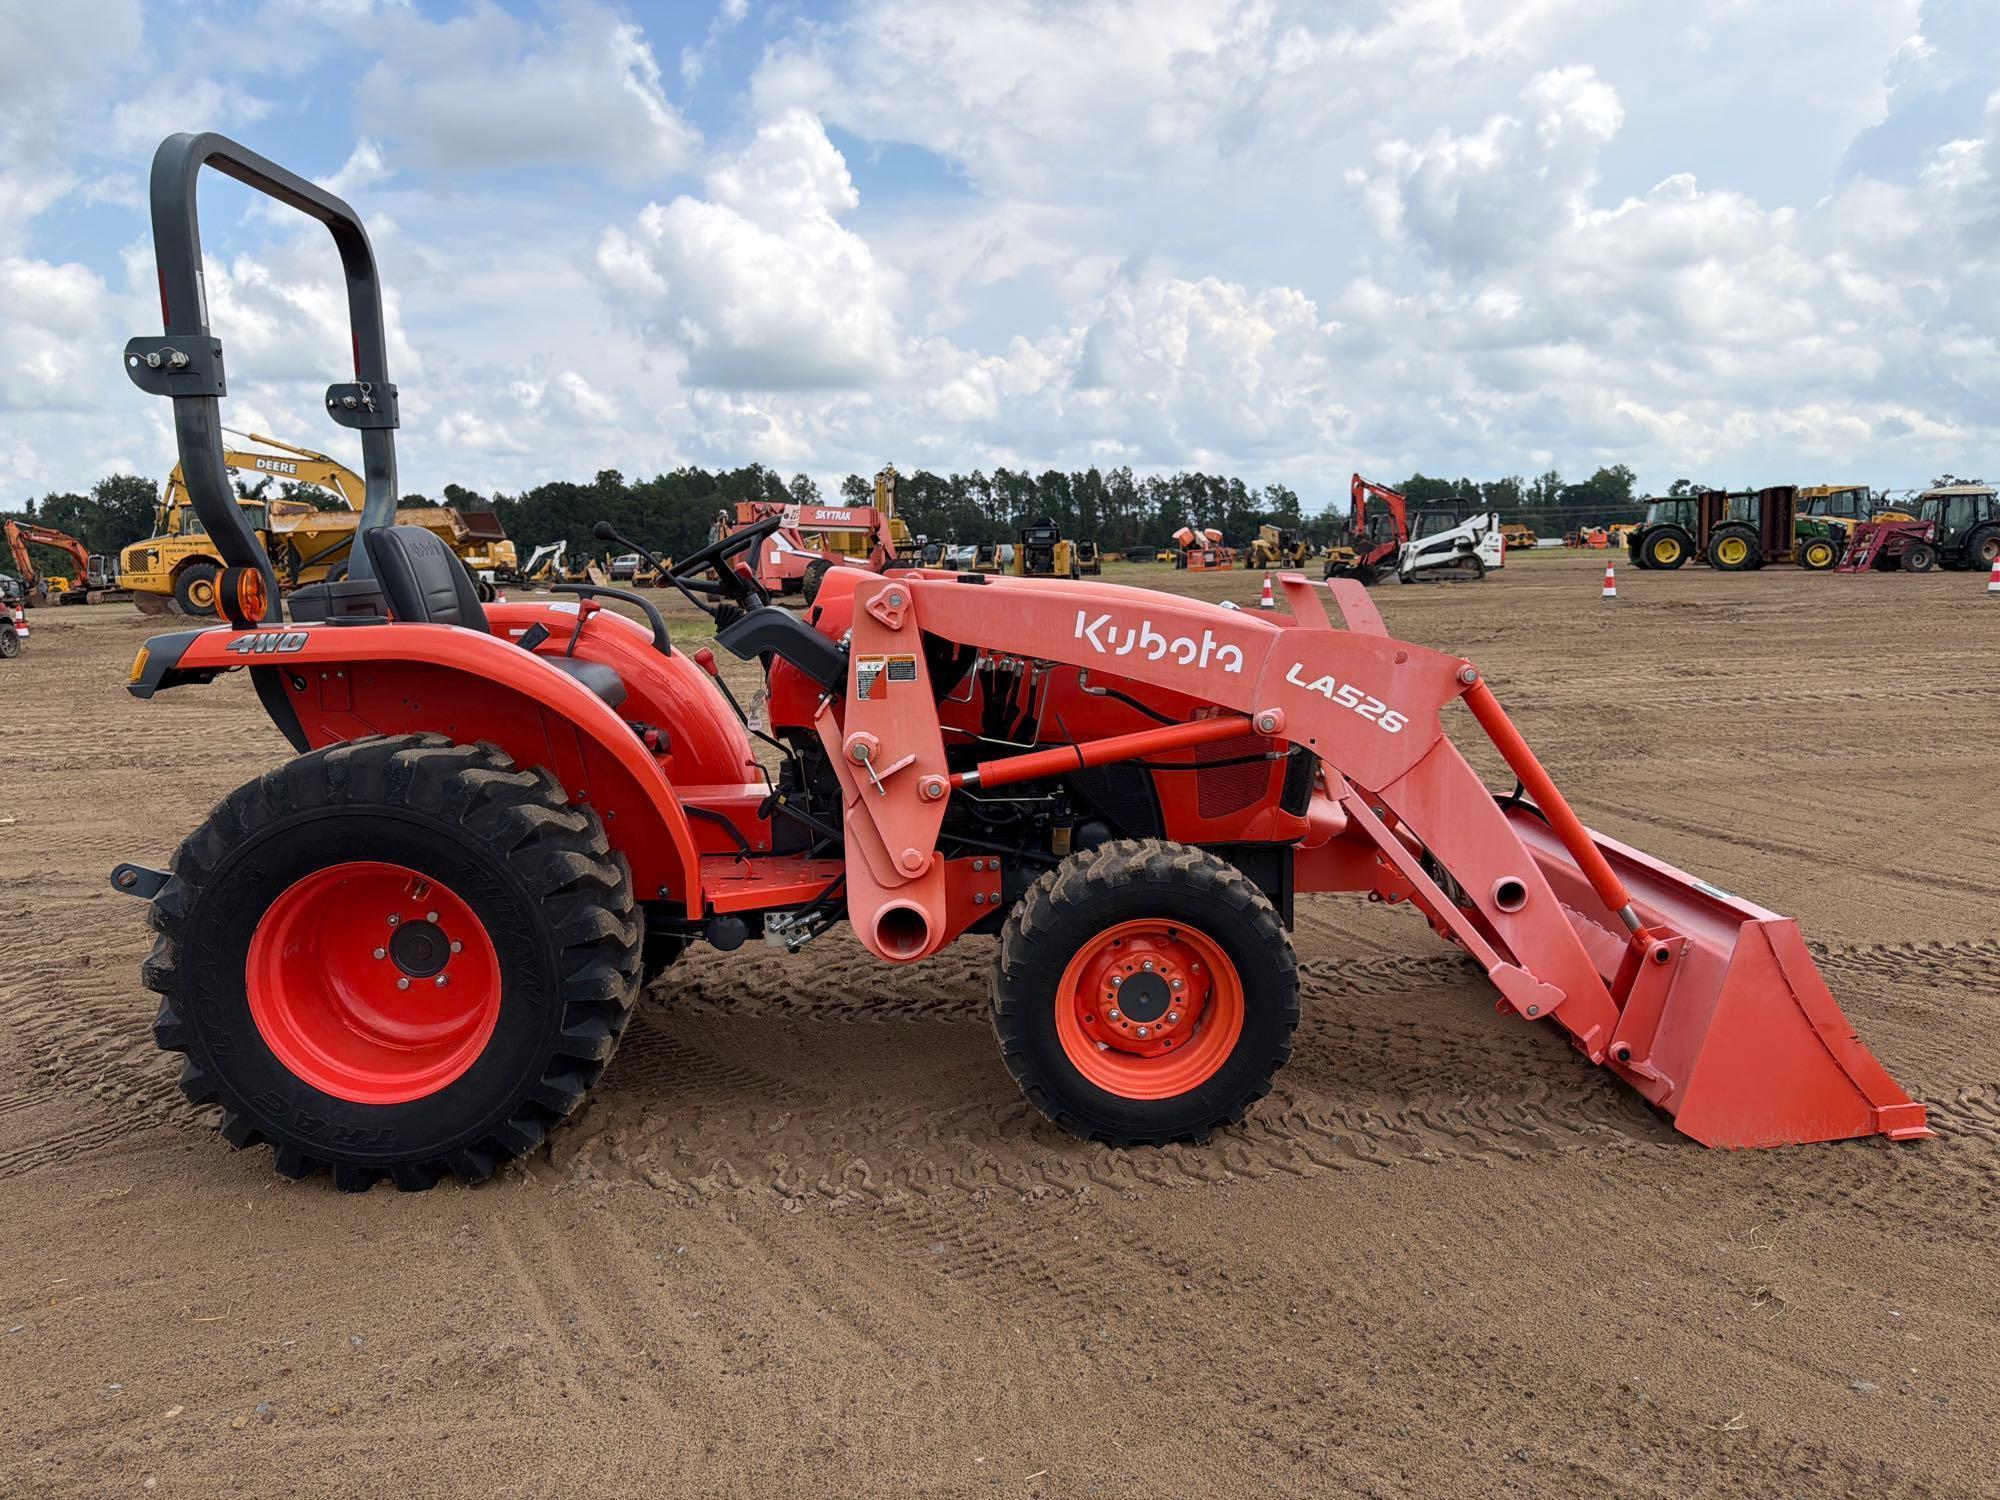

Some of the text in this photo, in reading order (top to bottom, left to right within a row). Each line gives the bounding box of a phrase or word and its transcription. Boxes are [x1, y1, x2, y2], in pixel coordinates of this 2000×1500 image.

[256, 458, 297, 474] DEERE
[815, 509, 852, 521] SKYTRAK
[225, 631, 309, 654] 4WD
[1073, 610, 1244, 674] Kubota
[1285, 662, 1410, 734] LA526
[459, 858, 545, 1009] TITAN
[250, 1088, 400, 1149] TRAC
